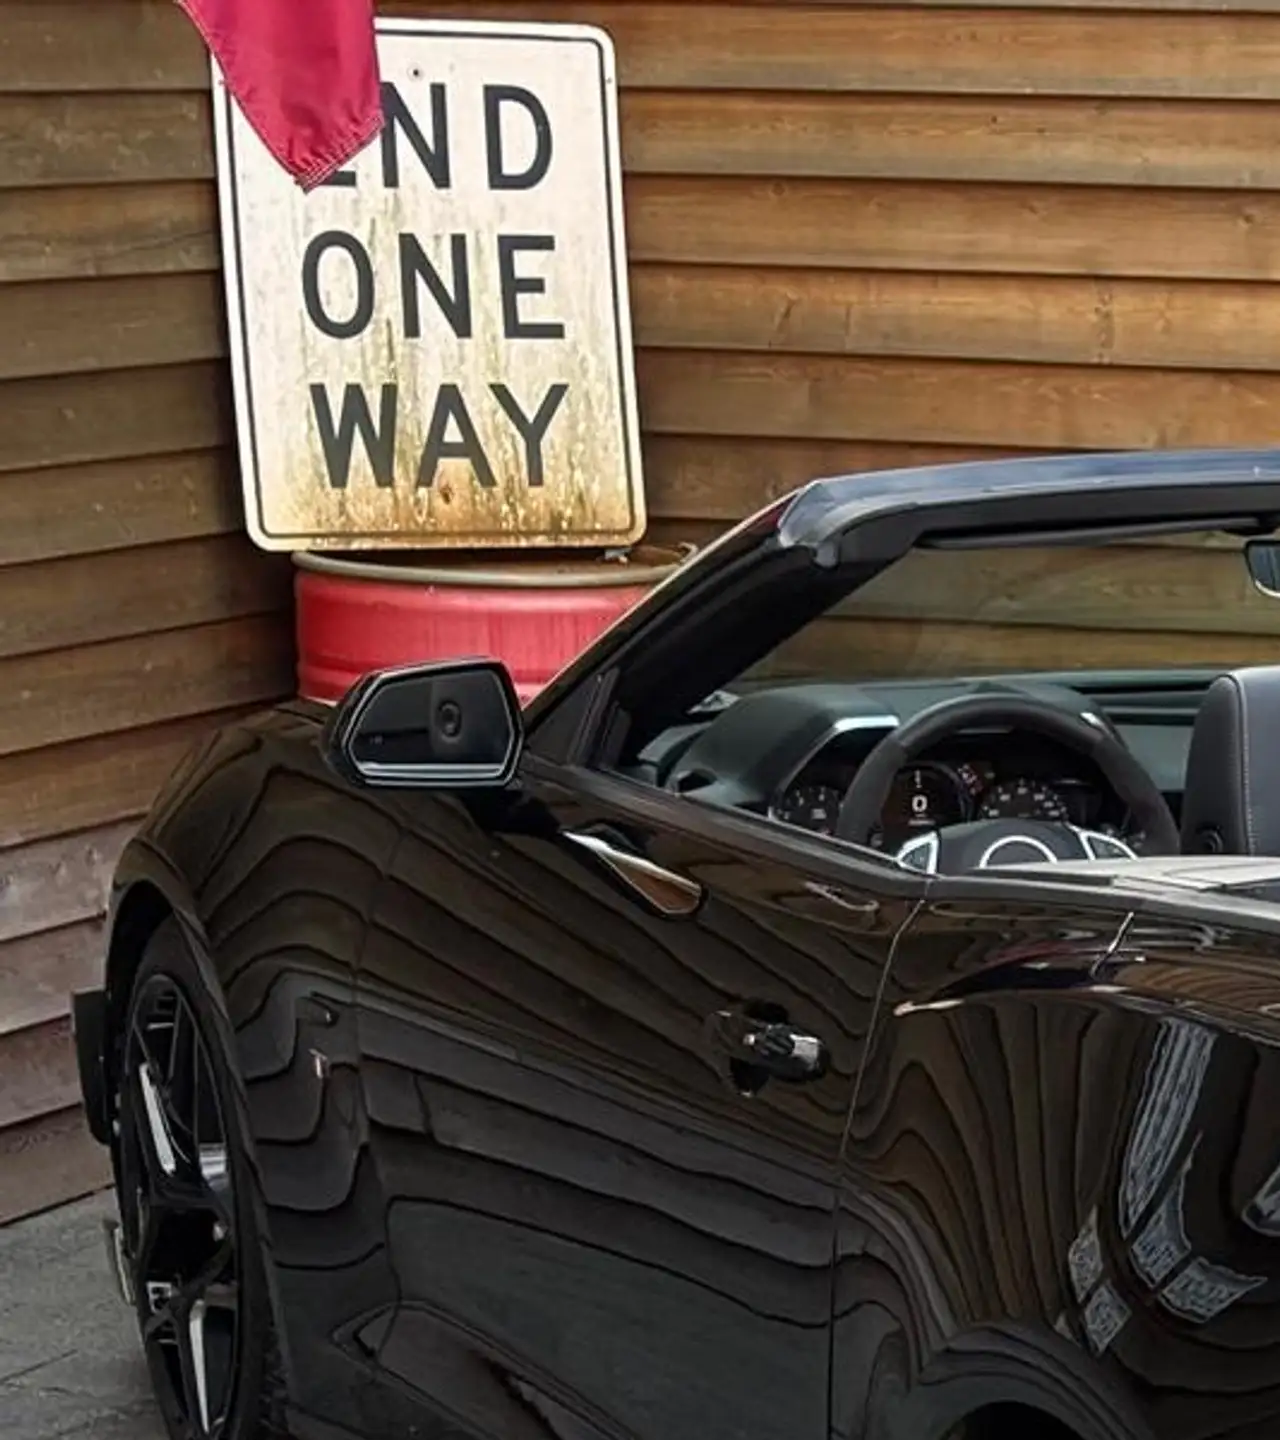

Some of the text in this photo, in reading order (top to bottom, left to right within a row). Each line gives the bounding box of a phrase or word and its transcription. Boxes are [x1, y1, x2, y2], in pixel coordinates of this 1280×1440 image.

[298, 81, 553, 190] ND
[301, 230, 566, 339] ONE
[309, 383, 569, 489] WAY
